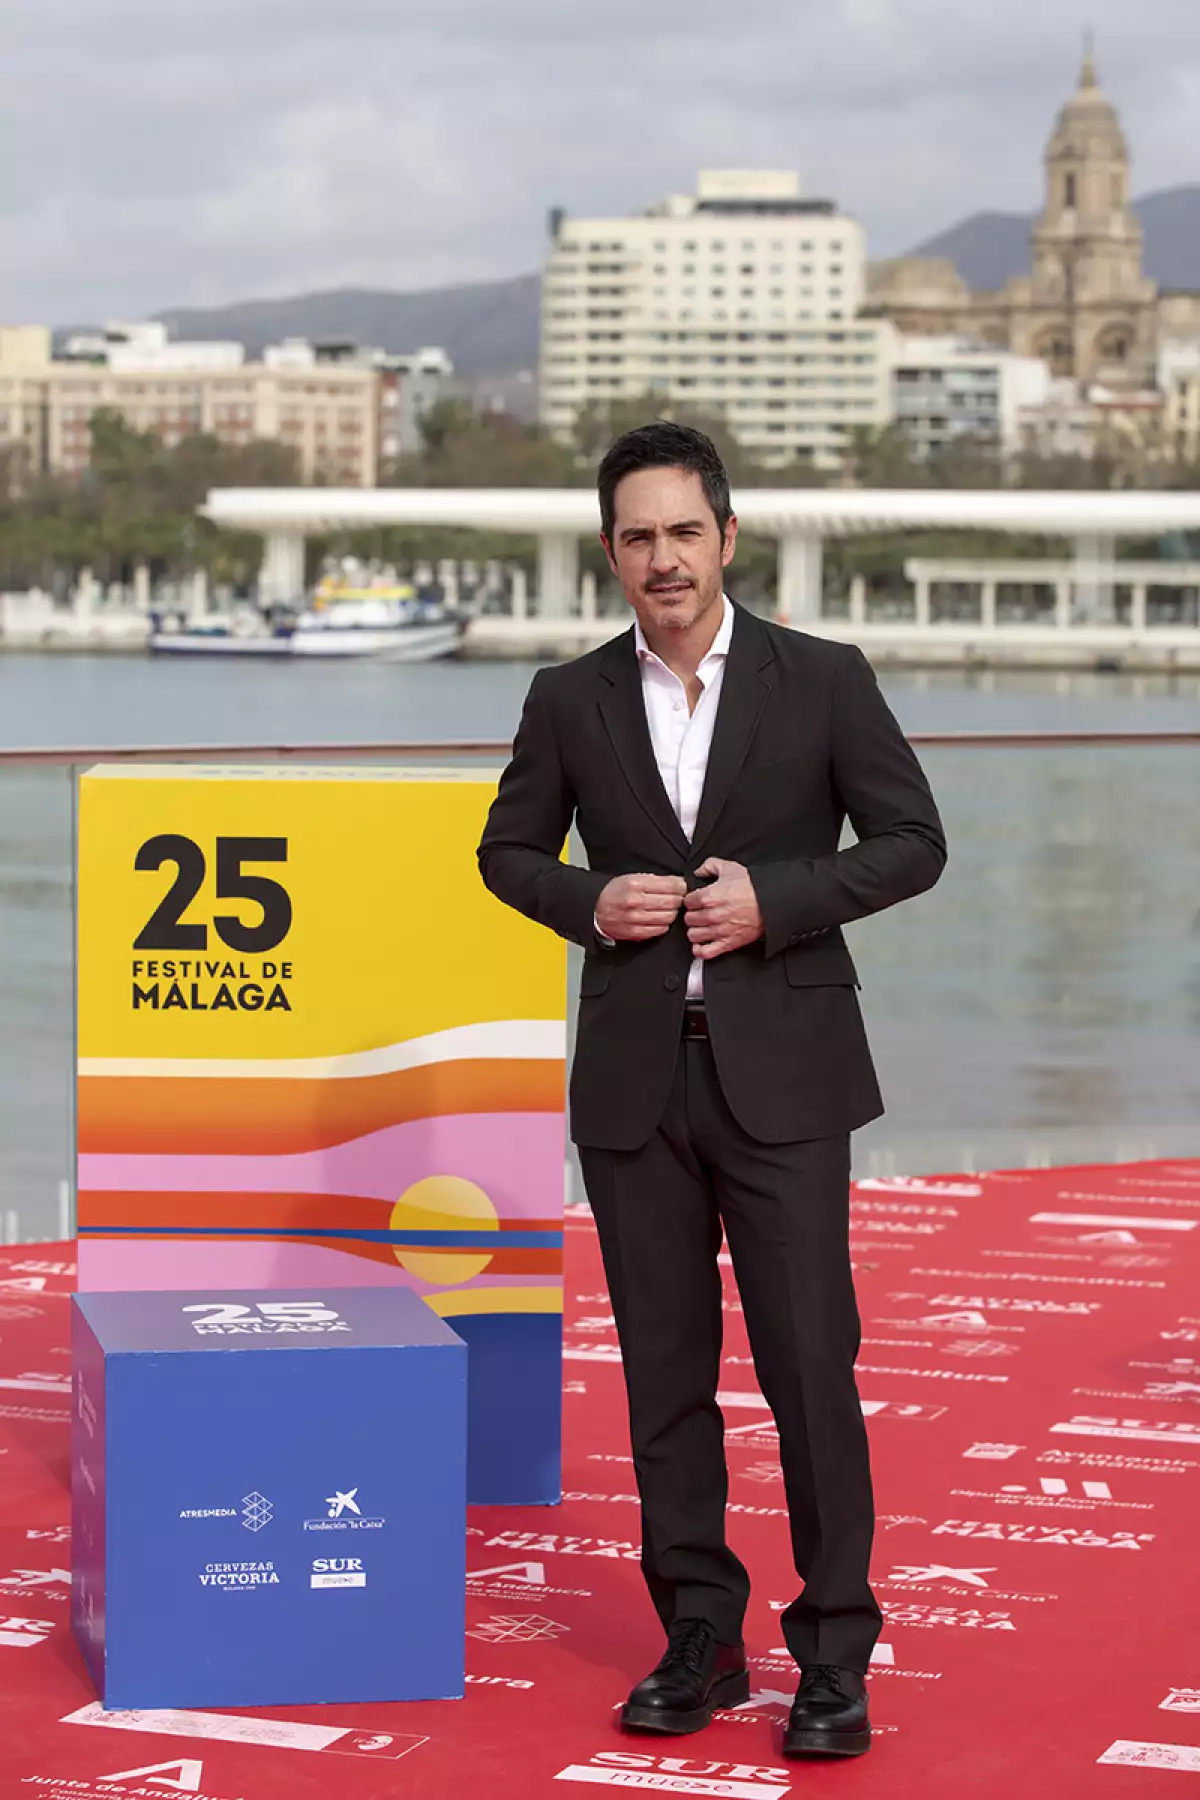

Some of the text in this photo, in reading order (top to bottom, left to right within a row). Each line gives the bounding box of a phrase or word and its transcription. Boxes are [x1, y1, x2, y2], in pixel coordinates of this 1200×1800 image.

[132, 833, 292, 954] 25
[132, 961, 292, 978] FESTIVAL DE
[132, 978, 292, 1011] MÁLAGA
[181, 1301, 339, 1324] 25
[1040, 1449, 1200, 1468] Ayuntamie
[179, 1508, 238, 1519] ATRESMEDIA
[205, 1561, 274, 1573] CERVEZAS
[312, 1558, 364, 1572] SUR
[199, 1571, 280, 1586] VICTORIA
[881, 1601, 1011, 1619] VEZAS
[868, 1668, 943, 1680] vincial
[589, 1751, 791, 1784] SUR
[20, 1775, 91, 1789] Junta
[95, 1784, 127, 1793] de
